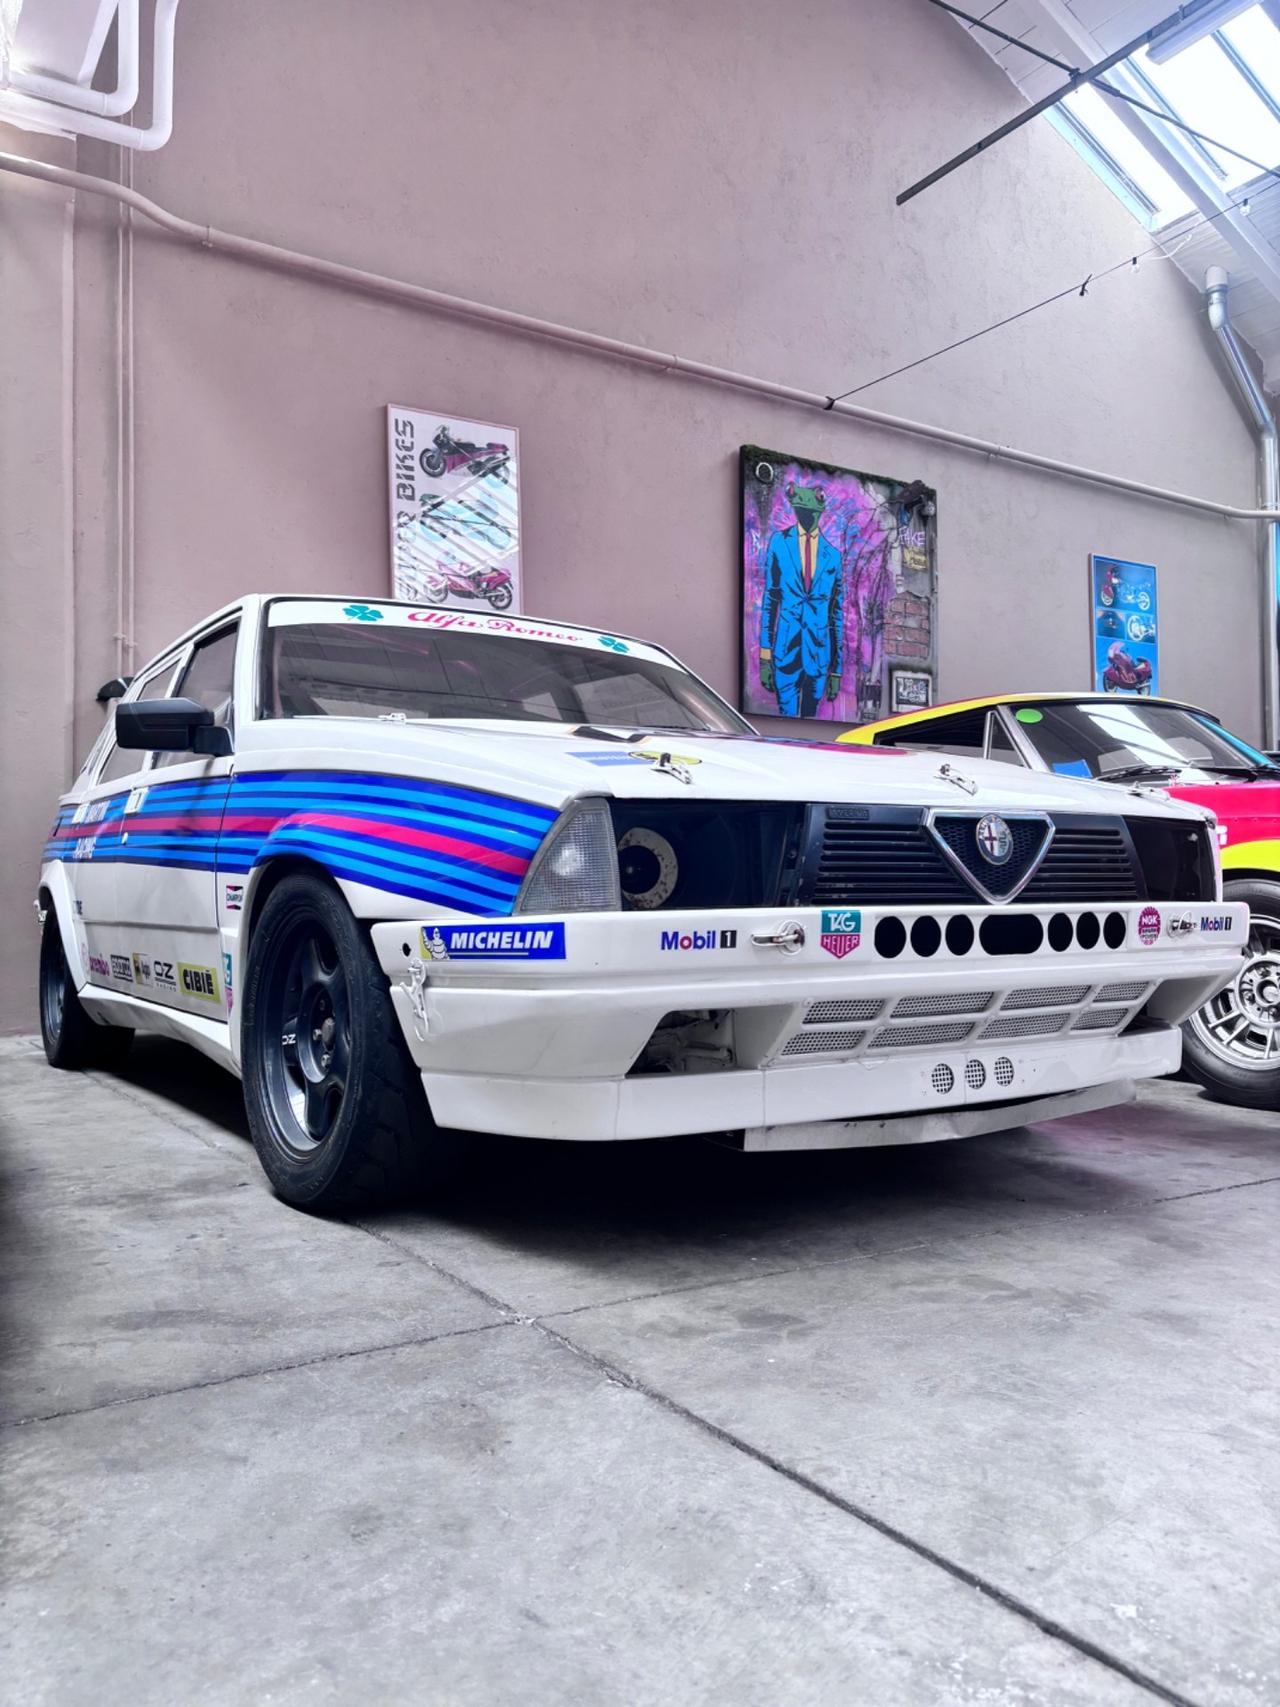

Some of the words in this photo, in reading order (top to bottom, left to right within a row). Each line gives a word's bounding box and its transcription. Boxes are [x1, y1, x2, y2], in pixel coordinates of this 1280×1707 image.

[394, 418, 416, 502] BIKES
[407, 611, 478, 629] Alfa
[487, 618, 580, 642] Romeo
[827, 912, 856, 932] TAG
[1141, 915, 1159, 926] NGK
[1200, 916, 1224, 931] Mobil
[450, 930, 553, 949] MICHELIN
[660, 930, 716, 951] Mobil
[822, 935, 860, 957] HEUER
[153, 960, 175, 980] OZ
